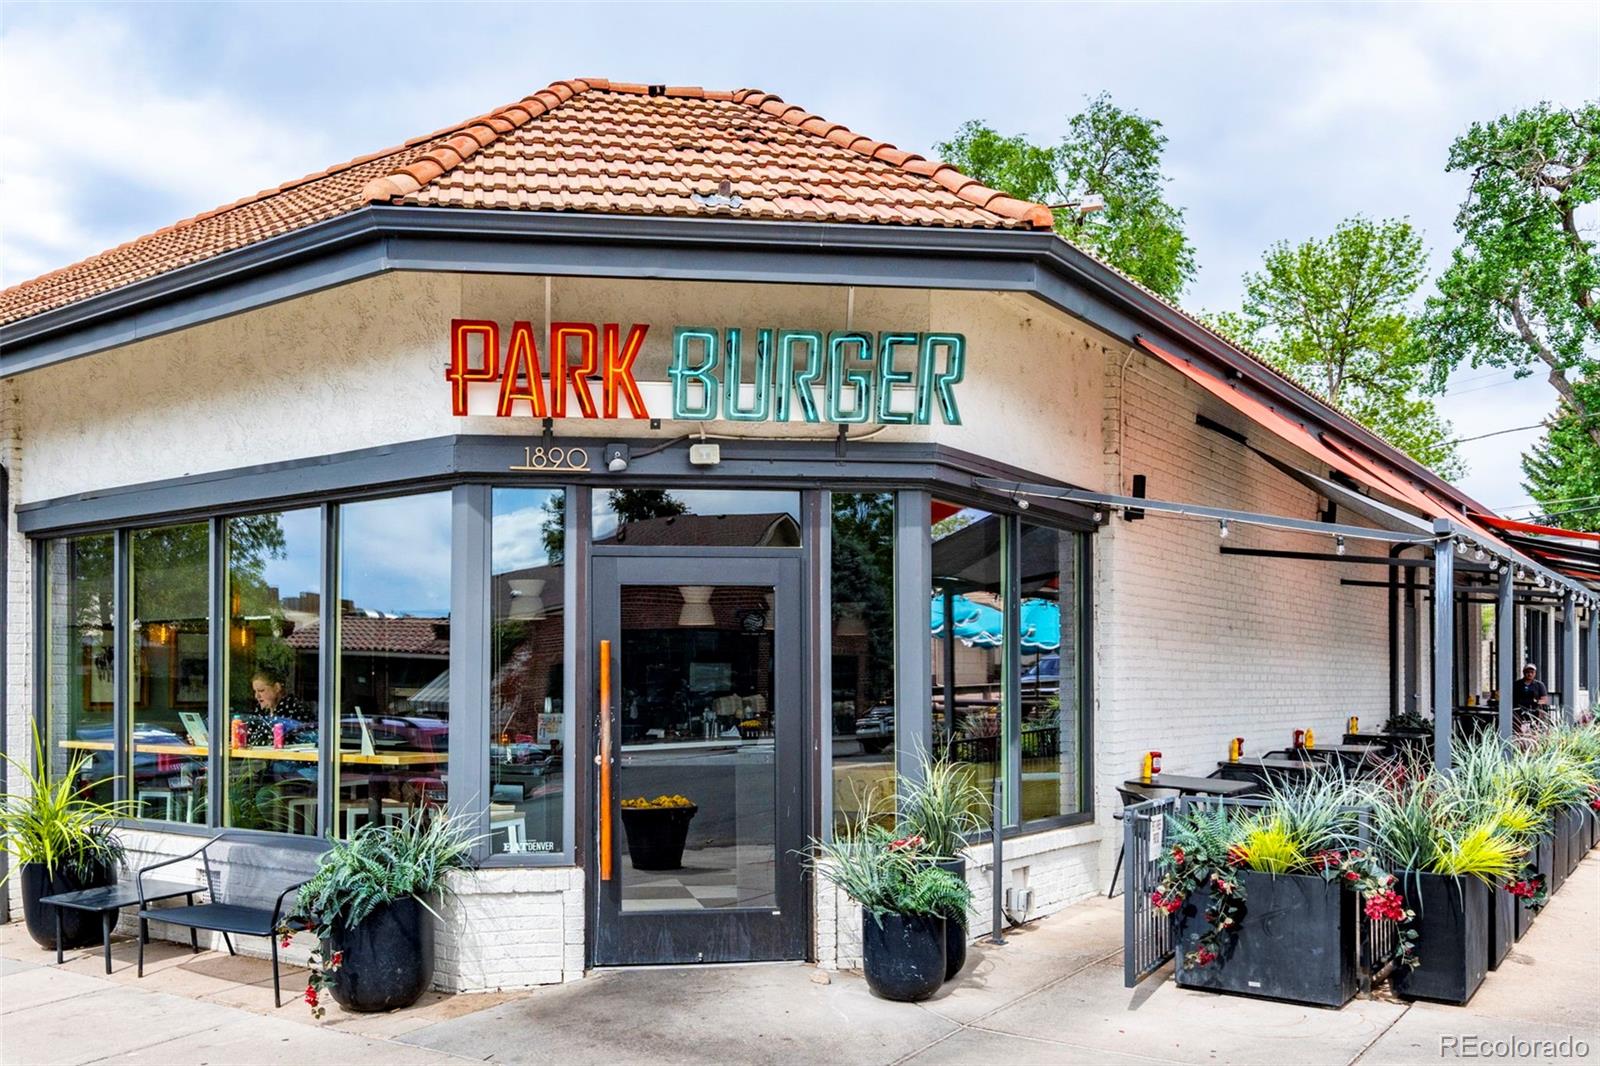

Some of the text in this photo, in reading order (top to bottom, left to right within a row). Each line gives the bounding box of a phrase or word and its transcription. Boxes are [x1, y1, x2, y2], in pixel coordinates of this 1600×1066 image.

[446, 319, 966, 425] PARK BURGER
[525, 447, 588, 469] 1890
